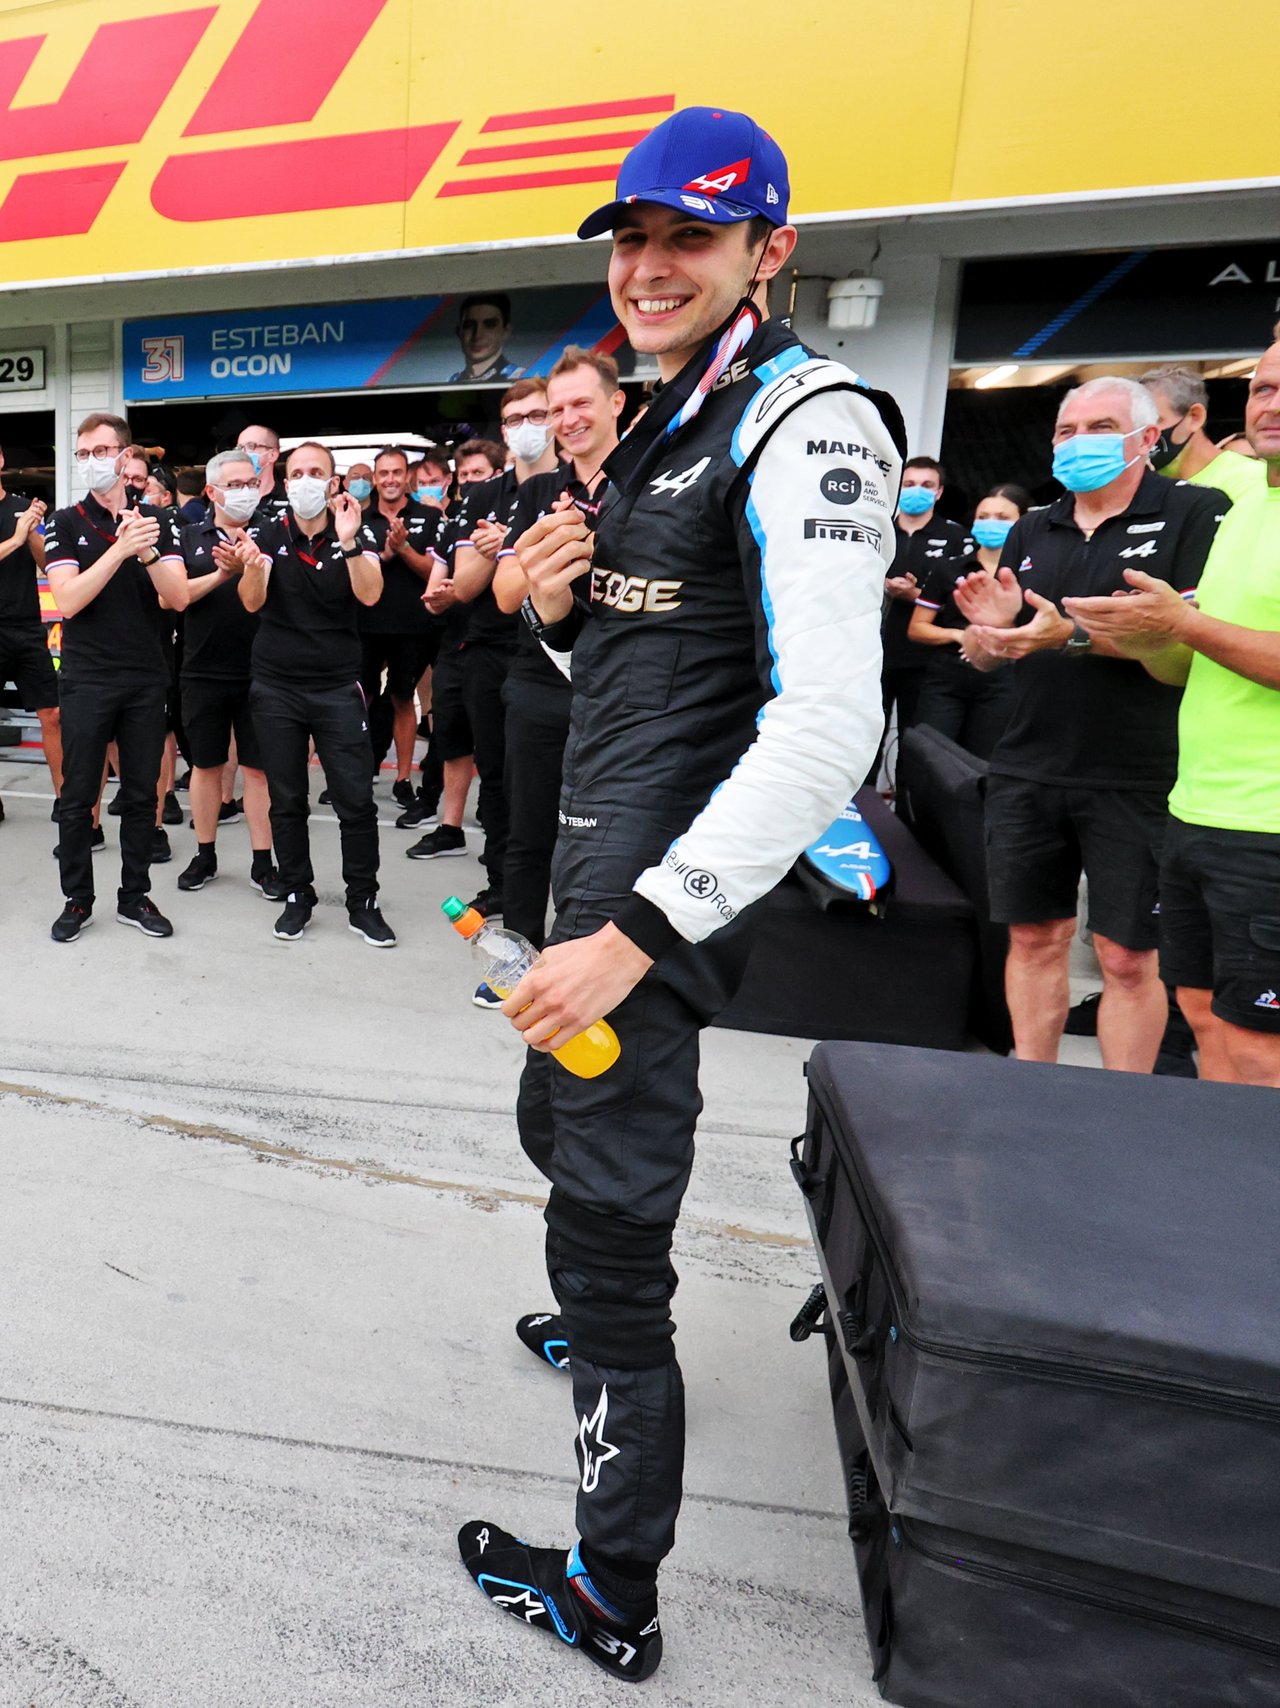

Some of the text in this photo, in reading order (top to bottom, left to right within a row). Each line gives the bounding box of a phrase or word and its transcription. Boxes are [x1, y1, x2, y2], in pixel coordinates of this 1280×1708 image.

[680, 194, 716, 215] 31
[211, 320, 345, 351] ESTEBAN
[141, 335, 185, 384] 31
[211, 352, 292, 379] OCON
[863, 488, 879, 497] AND
[592, 1630, 637, 1667] 31
